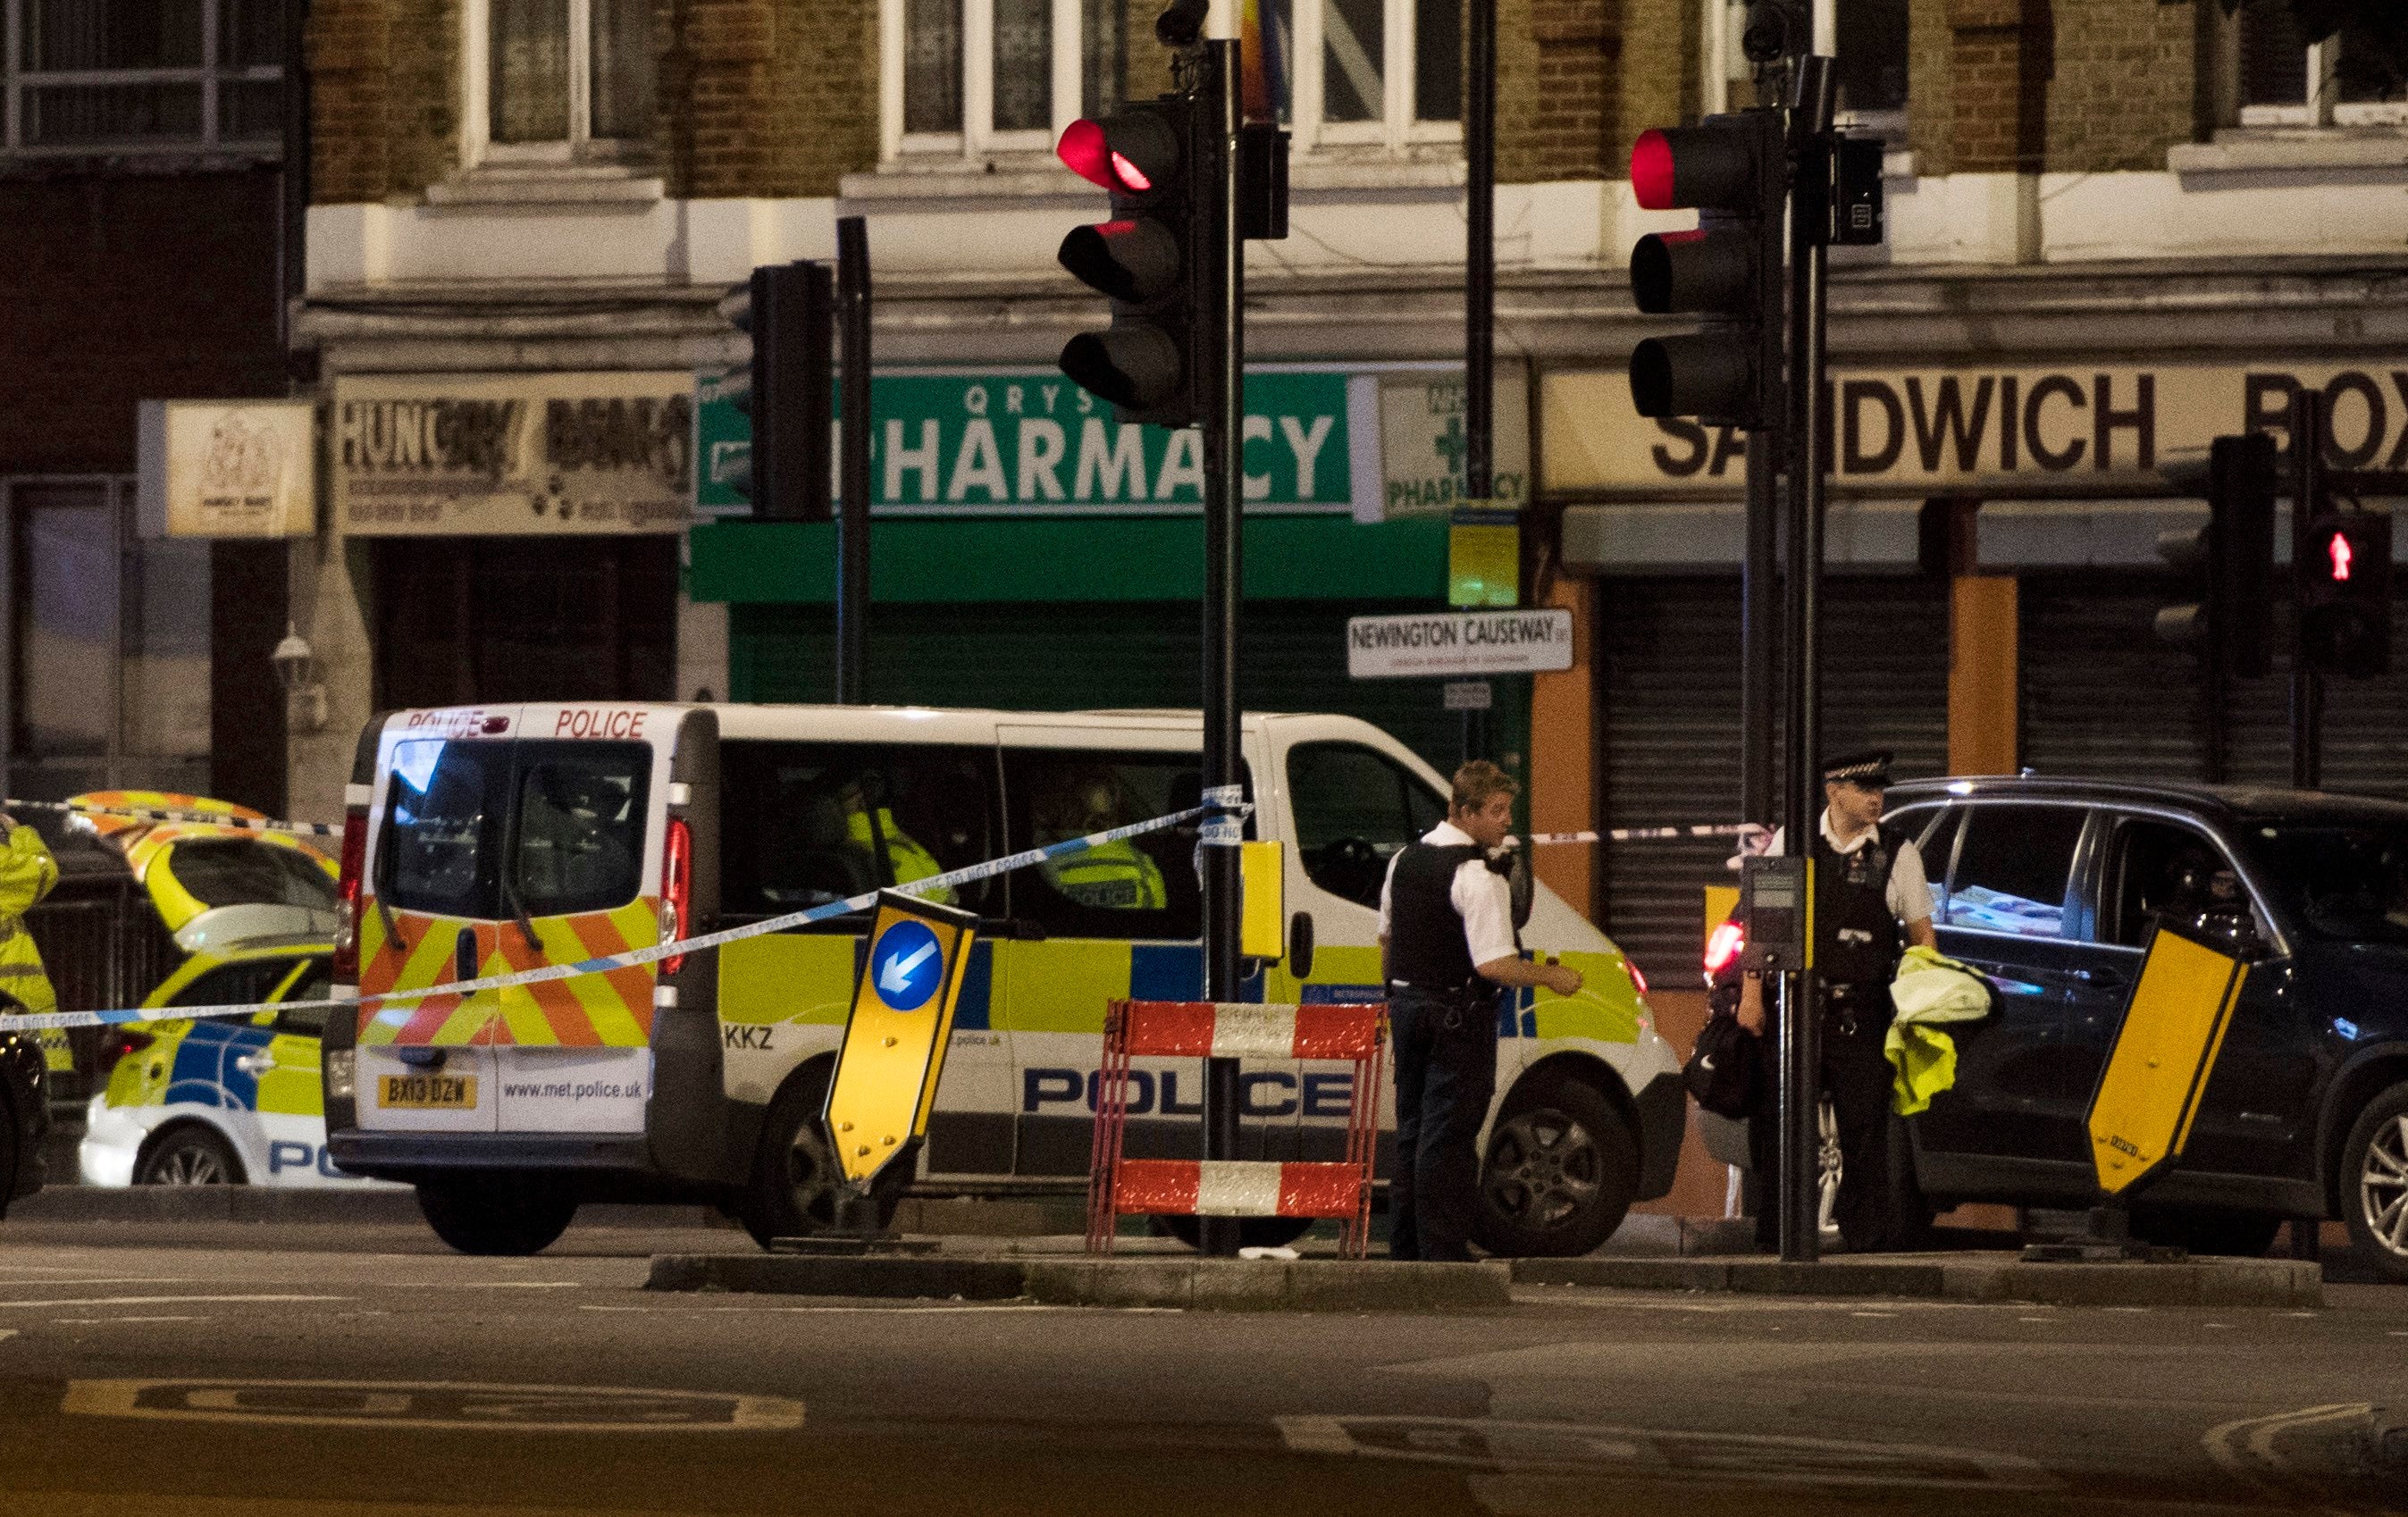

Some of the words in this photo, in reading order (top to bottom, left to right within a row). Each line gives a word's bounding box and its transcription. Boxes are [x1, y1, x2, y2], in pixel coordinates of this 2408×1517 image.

[1651, 373, 2155, 478] SDWICH
[1387, 473, 1523, 507] PHARCY
[1352, 621, 1456, 650] NEWINGTON
[1464, 617, 1554, 645] CAUSEWAY
[408, 710, 483, 738] POLICE
[556, 709, 648, 739] POLICE
[725, 1026, 774, 1051] KKZ
[388, 1077, 426, 1102] BX13
[504, 1079, 642, 1102] www.met.police.uk
[1023, 1068, 1356, 1117] POLCE
